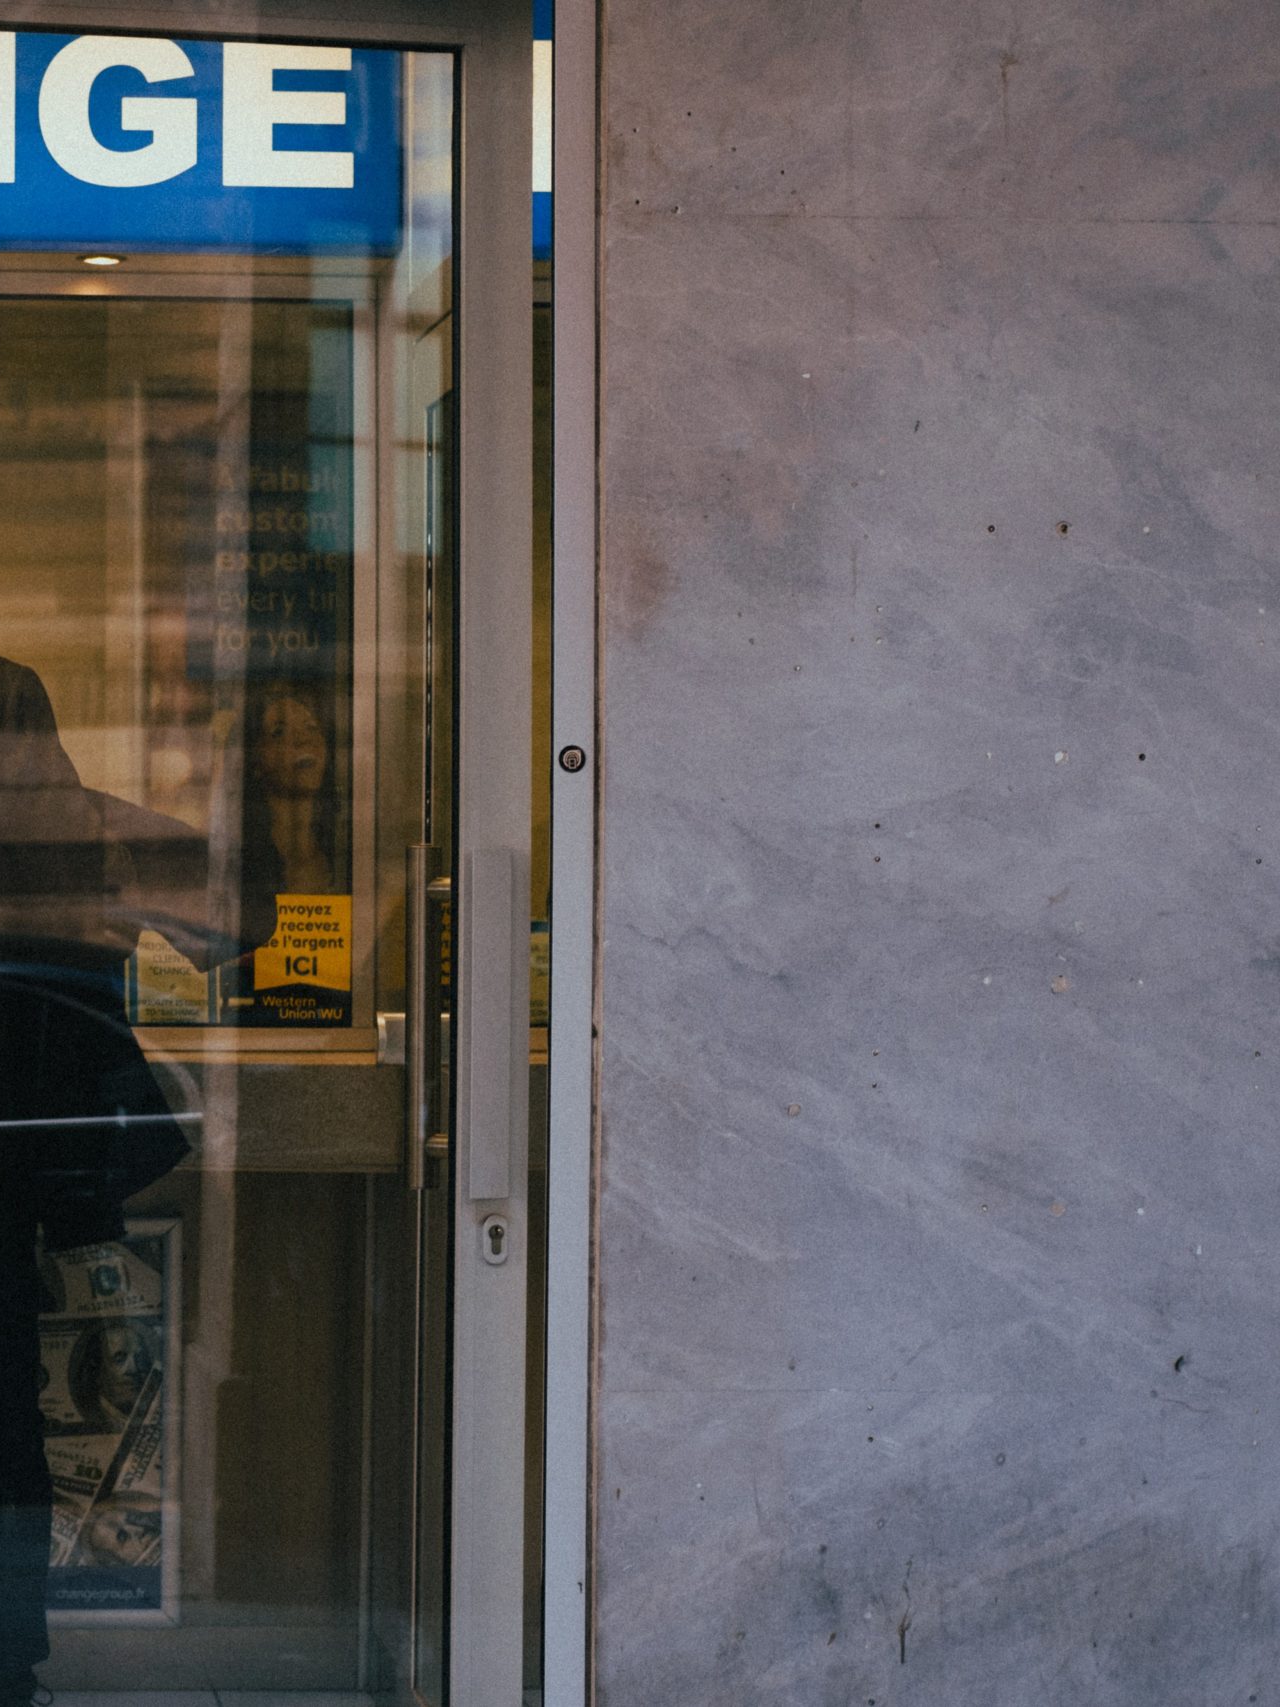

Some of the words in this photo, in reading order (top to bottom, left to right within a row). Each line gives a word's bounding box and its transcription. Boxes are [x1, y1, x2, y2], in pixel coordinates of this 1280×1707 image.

[280, 921, 340, 932] recevez
[283, 936, 344, 951] l'argent
[285, 956, 318, 976] ICI
[262, 996, 317, 1008] Western
[278, 1008, 317, 1020] Union
[319, 1008, 343, 1020] WU
